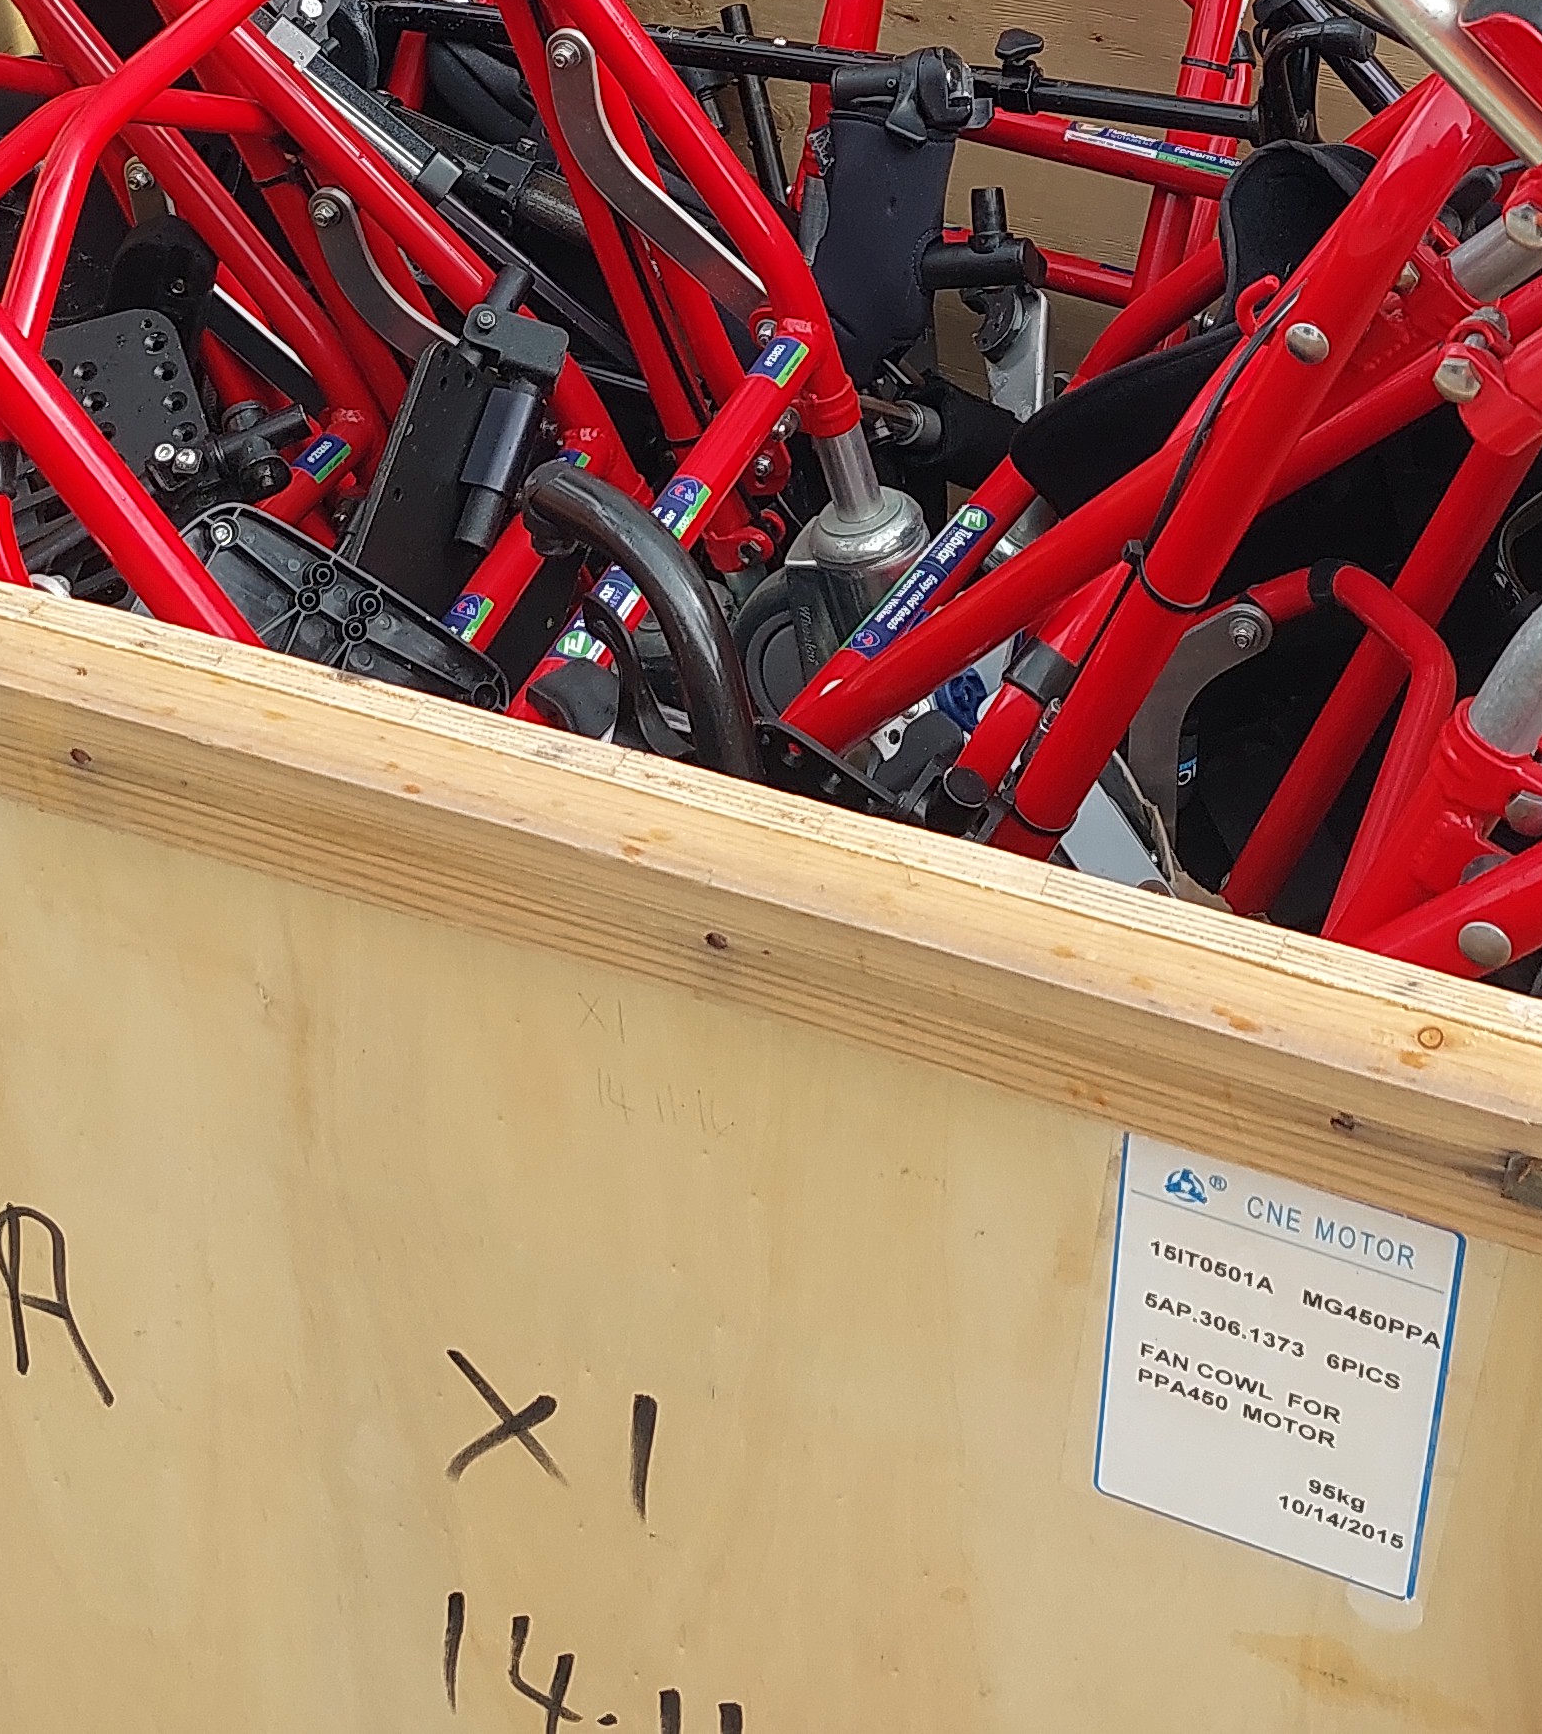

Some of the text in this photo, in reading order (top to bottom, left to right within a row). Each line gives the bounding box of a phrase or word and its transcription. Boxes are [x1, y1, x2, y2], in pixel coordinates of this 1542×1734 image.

[936, 528, 973, 565] Tubular
[1246, 1195, 1415, 1271] CNE MOTOR
[1149, 1240, 1442, 1351] 15IT0501A MG450PPA
[1144, 1291, 1402, 1391] 5AP.306.1373 6PICS
[1137, 1367, 1337, 1450] PPA450 MOTOR
[1139, 1341, 1342, 1425] FAN COWL FOR
[1278, 1494, 1405, 1550] 10/14/2015
[1307, 1478, 1366, 1515] 95kg
